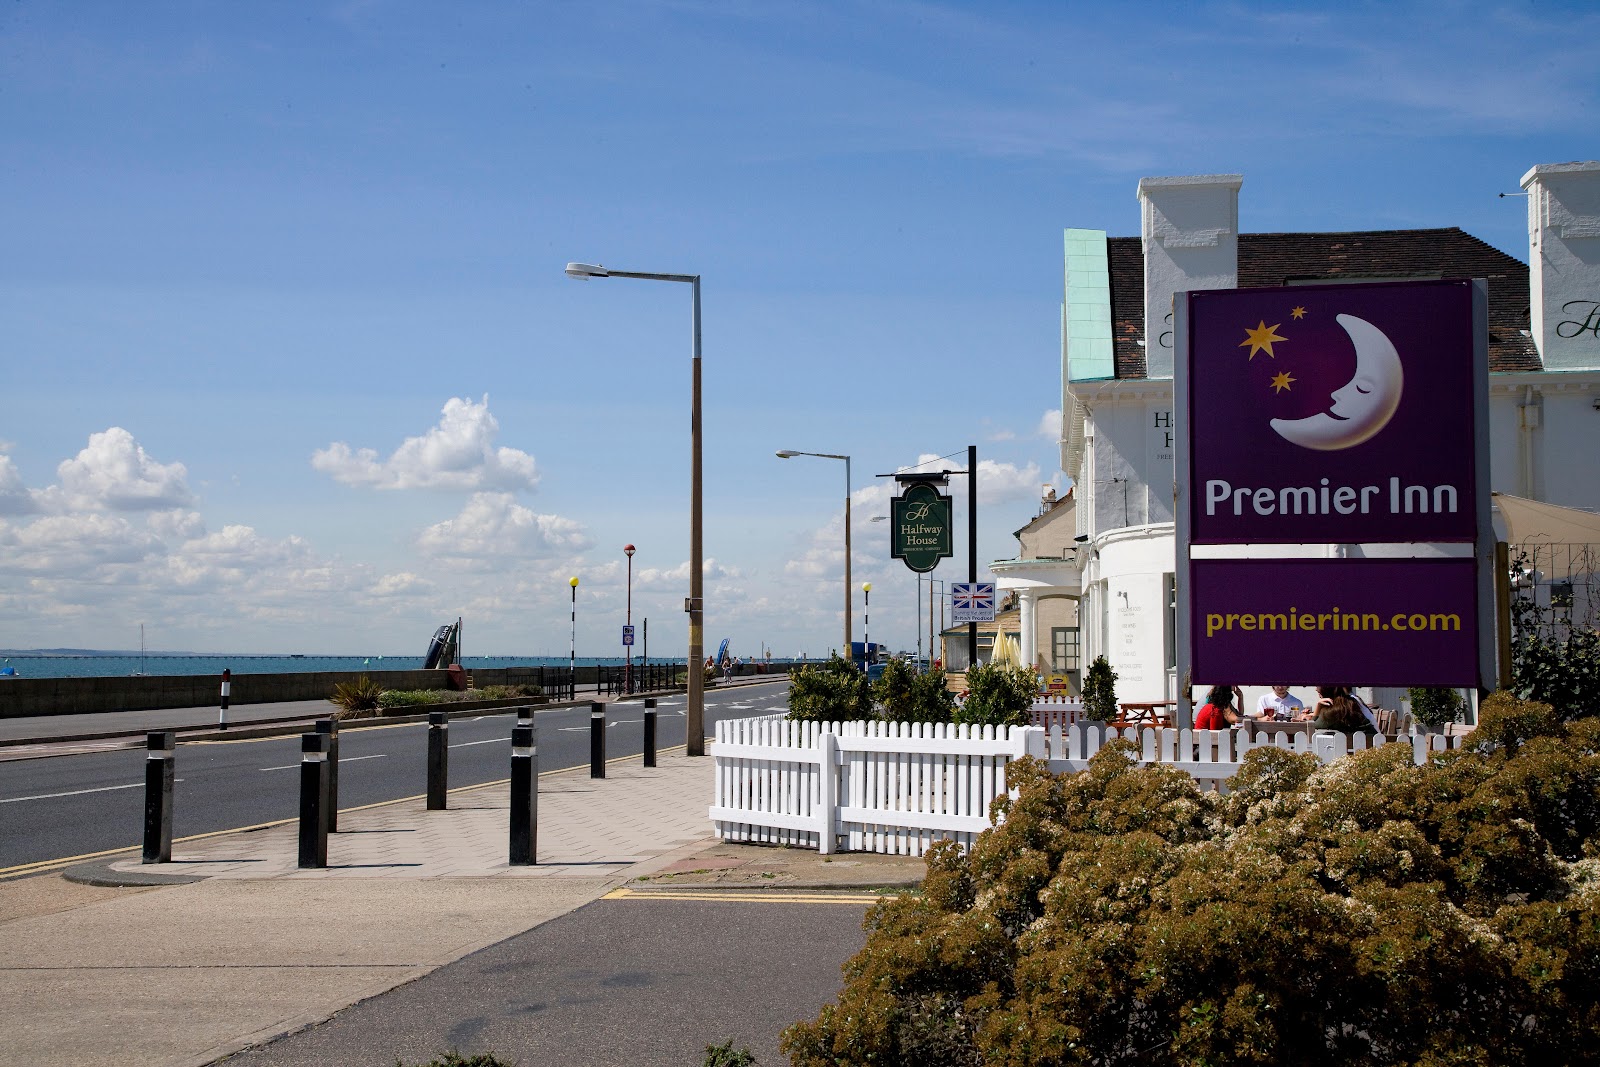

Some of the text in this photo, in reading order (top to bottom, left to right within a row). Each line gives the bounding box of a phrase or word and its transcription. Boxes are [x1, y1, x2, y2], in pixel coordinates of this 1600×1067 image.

[1206, 476, 1458, 516] Premier Inn
[901, 524, 942, 536] Halfway
[906, 536, 938, 545] House
[1206, 606, 1461, 638] premierinn.com
